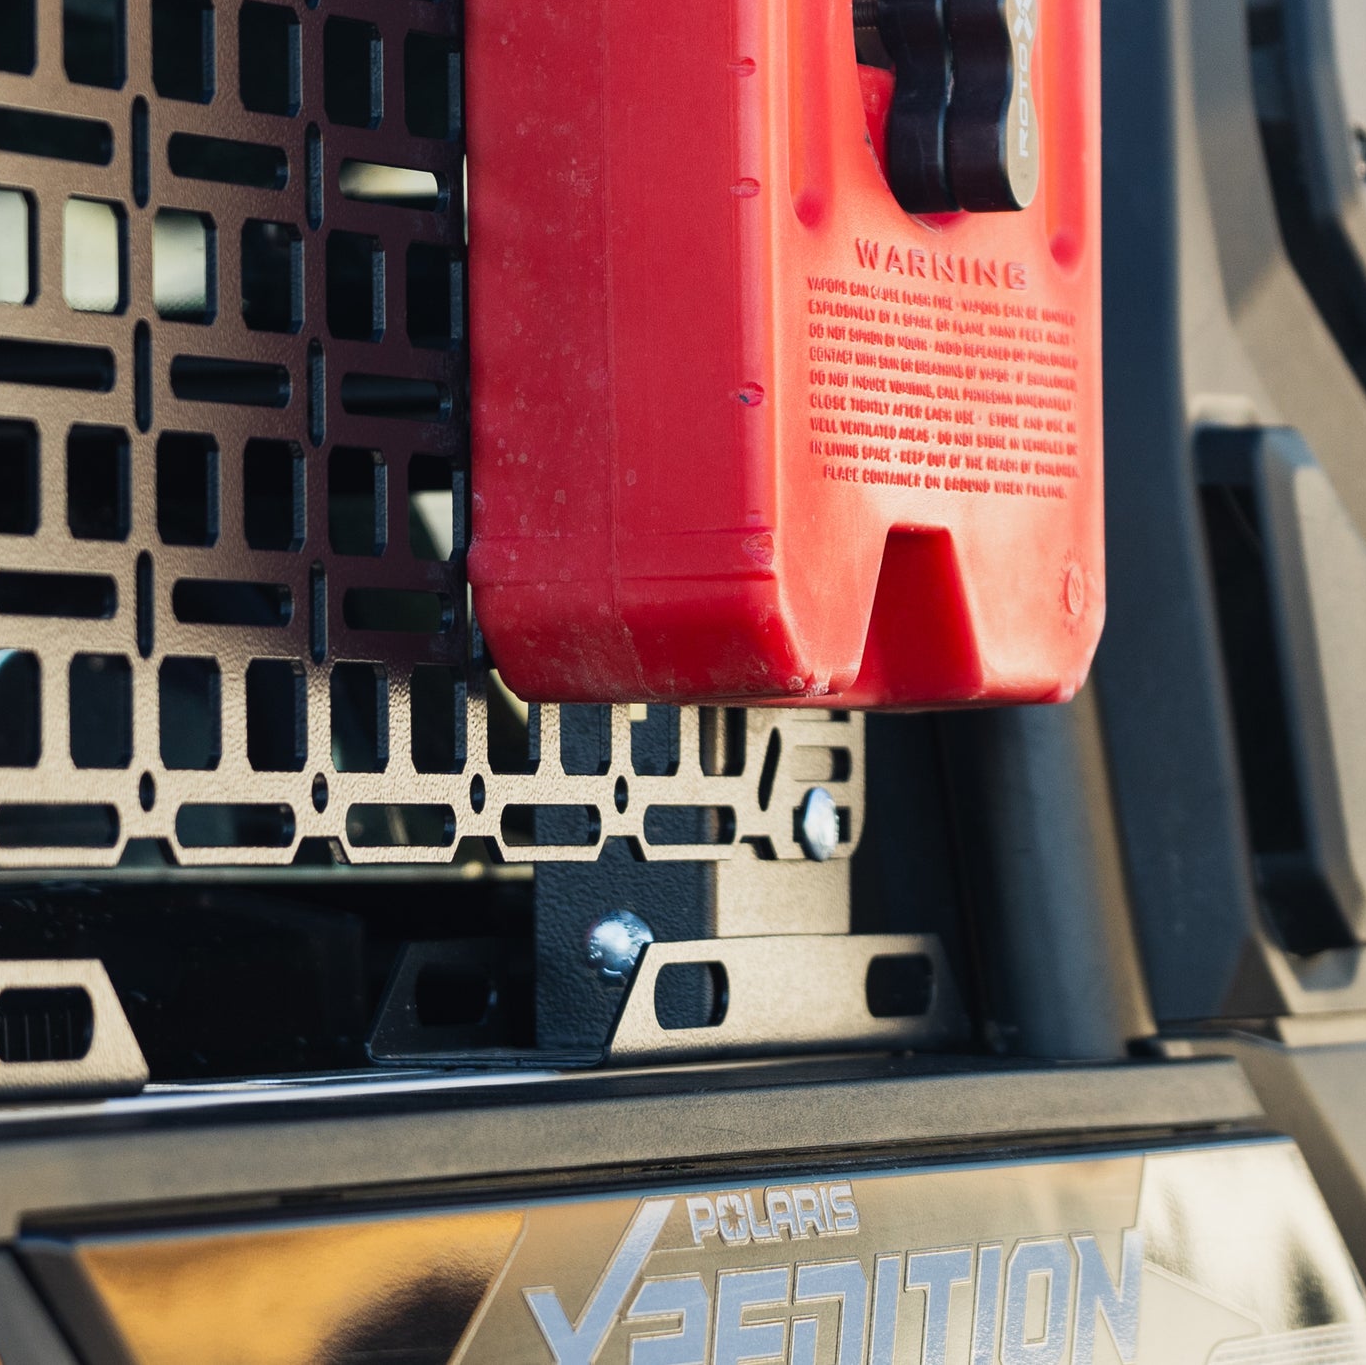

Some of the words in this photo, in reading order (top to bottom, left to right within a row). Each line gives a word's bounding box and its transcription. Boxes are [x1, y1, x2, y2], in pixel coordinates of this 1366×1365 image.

[855, 237, 1029, 290] WARNING
[849, 282, 869, 298] CAN
[808, 300, 876, 322] EXPLOSIVELY
[893, 311, 900, 325] A
[809, 323, 824, 337] DO
[826, 325, 847, 340] NOT
[848, 328, 883, 345] SIPHON
[809, 347, 853, 365] CONTACT
[855, 352, 877, 368] WITH
[878, 356, 899, 371] SKIN
[901, 358, 914, 373] OR
[809, 369, 826, 385] DO
[828, 372, 849, 388] NOT
[852, 375, 887, 393] INDUCE
[809, 392, 847, 411] CLOSE
[850, 398, 890, 416] TIGHTLY
[892, 403, 923, 421] AFTER
[925, 407, 952, 422] EACH
[954, 408, 975, 425] USE
[810, 417, 838, 433] WELL
[840, 420, 897, 439] VENTILATED
[898, 427, 930, 443] AREAS
[937, 431, 952, 445] DO
[954, 433, 974, 447] NOT
[976, 435, 1007, 450] STORE
[810, 440, 822, 454] IN
[825, 442, 859, 458] LIVING
[862, 446, 891, 462] SPACE
[900, 450, 925, 466] KEEP
[927, 453, 947, 467] OUT
[949, 455, 962, 468] OF
[965, 456, 983, 470] THE
[823, 464, 859, 482] PLACE
[862, 468, 921, 488] CONTAINER
[924, 475, 941, 491] ON
[994, 482, 1024, 497] WHEN
[685, 1183, 859, 1246] POLARIS
